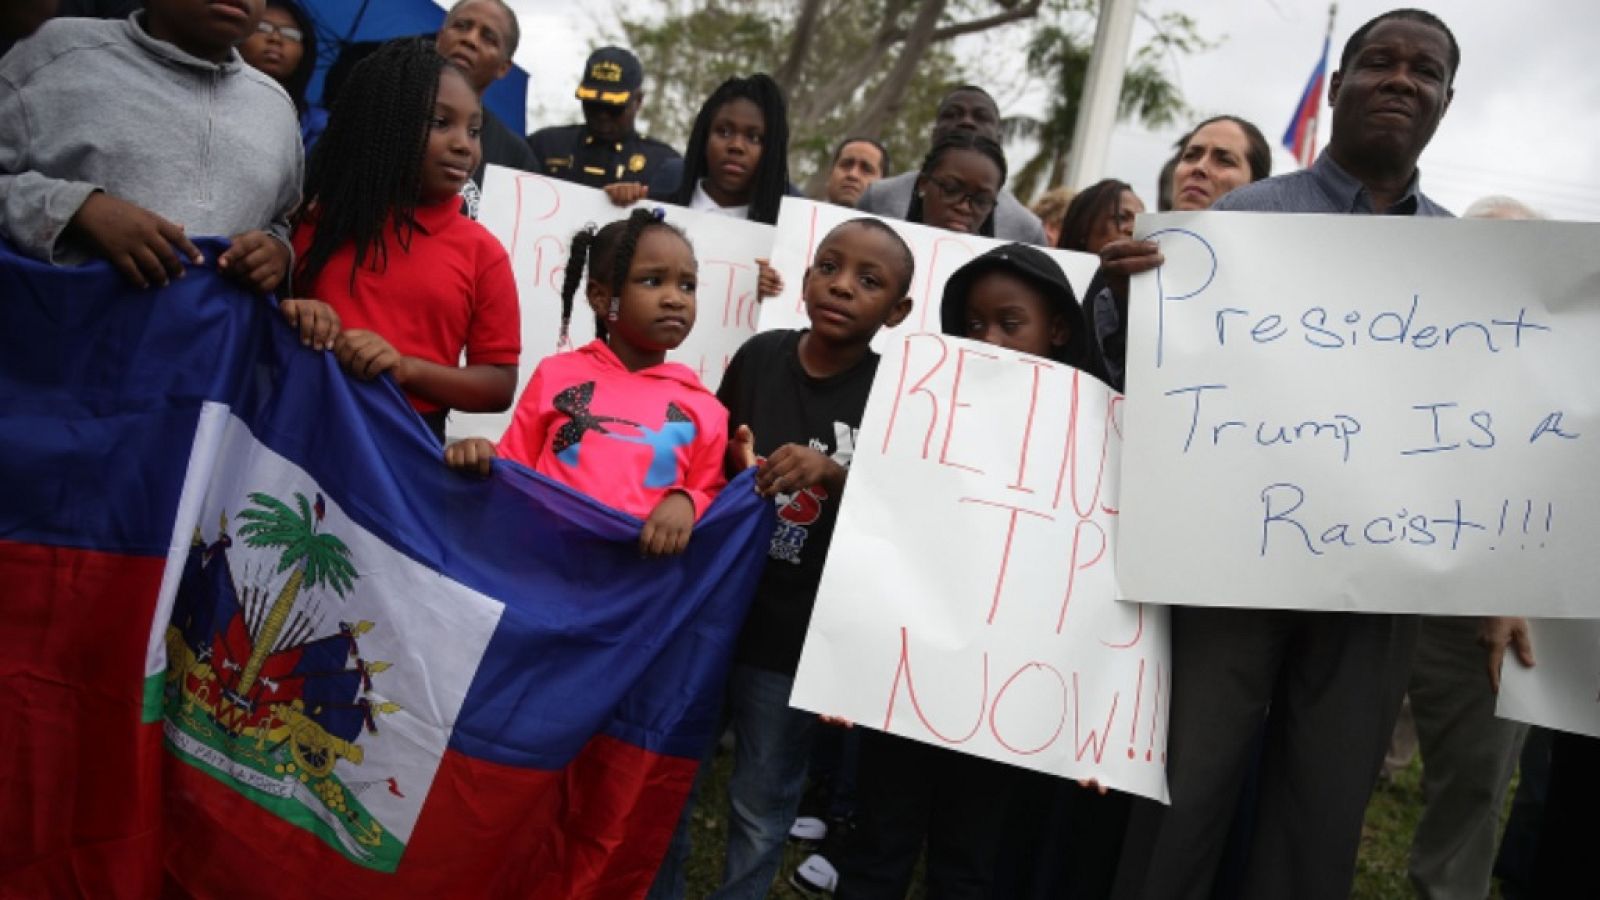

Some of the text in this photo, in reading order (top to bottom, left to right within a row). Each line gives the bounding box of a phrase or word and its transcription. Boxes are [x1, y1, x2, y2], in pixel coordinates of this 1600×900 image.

[1143, 228, 1551, 368] President
[1164, 384, 1361, 462] Trump
[1260, 483, 1553, 557] Racist!!!
